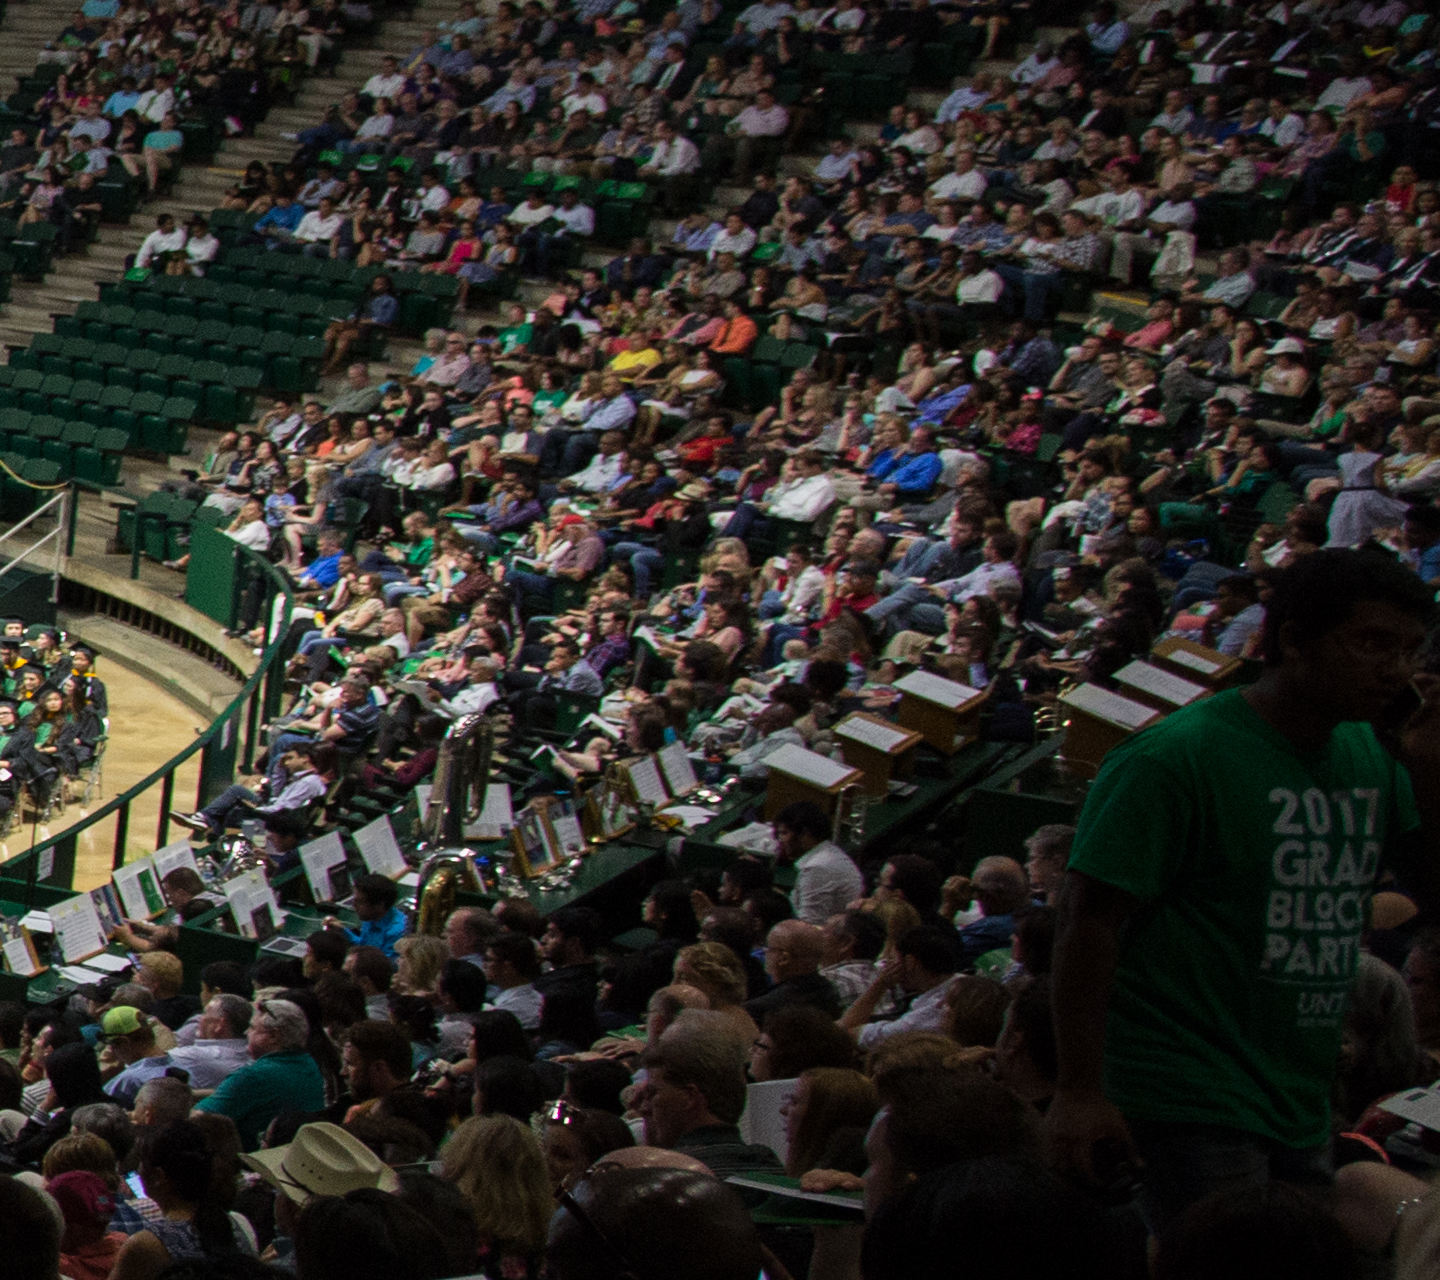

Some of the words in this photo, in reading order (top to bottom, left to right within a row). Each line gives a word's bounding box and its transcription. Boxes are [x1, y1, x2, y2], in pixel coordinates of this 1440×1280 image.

[1268, 787, 1380, 836] 2017
[1272, 839, 1380, 887] GRAD
[1260, 932, 1362, 976] PART
[1297, 992, 1348, 1015] UNT
